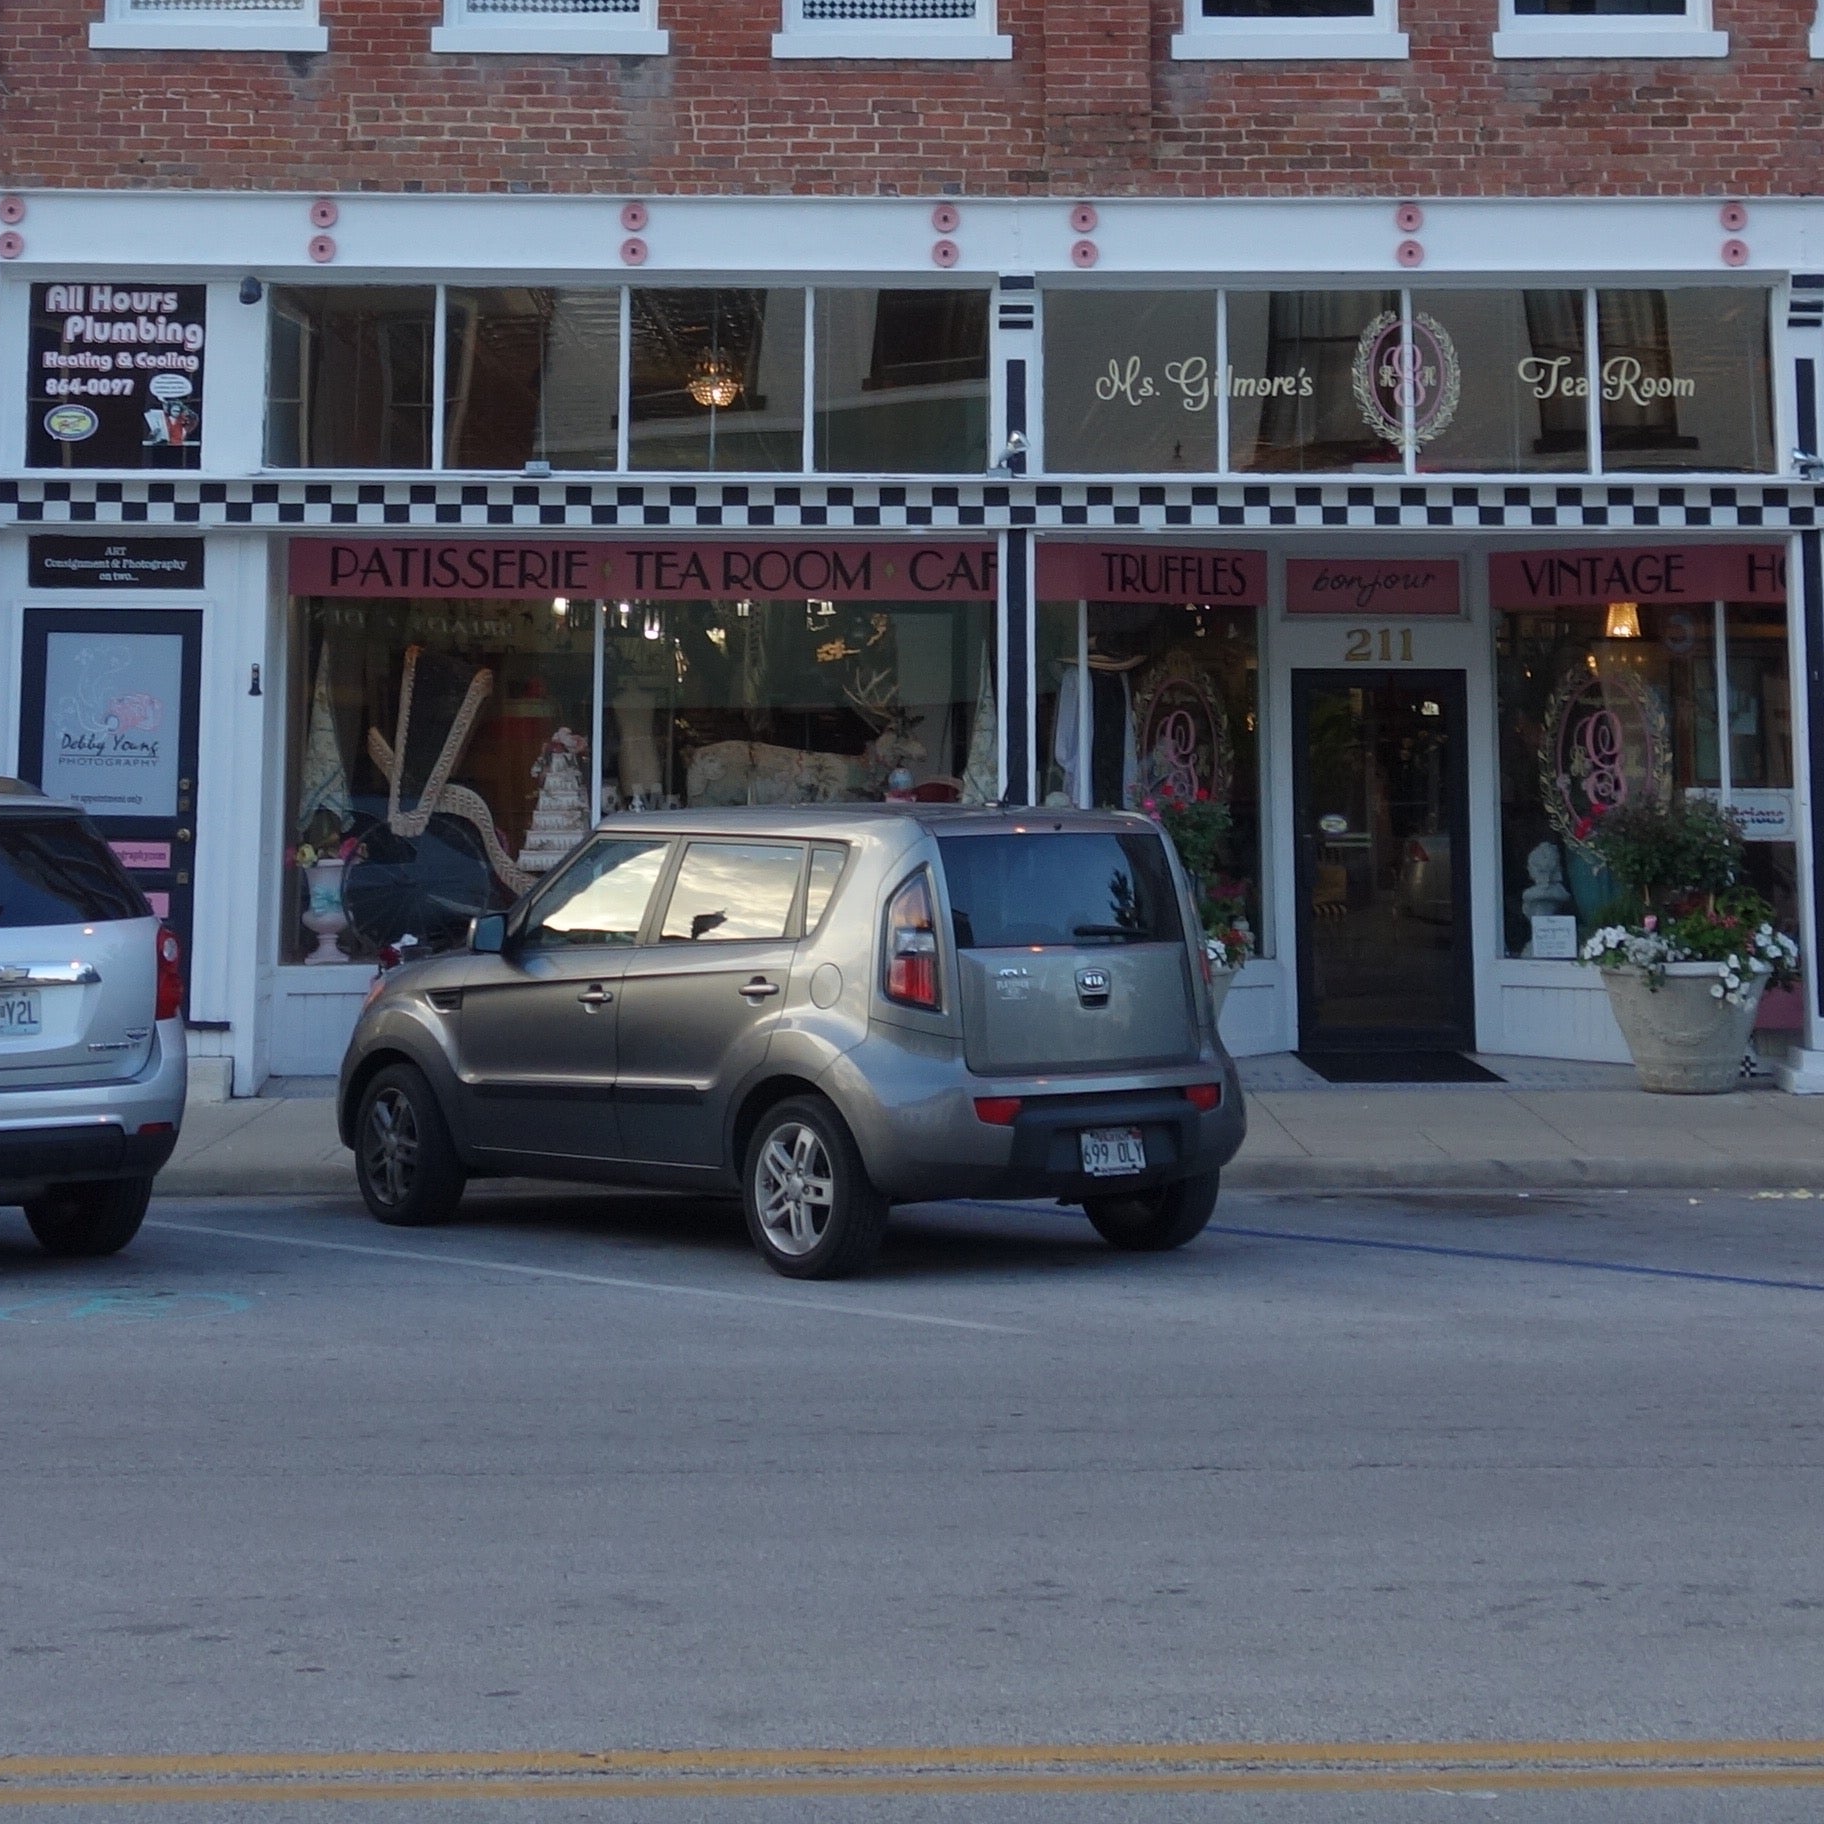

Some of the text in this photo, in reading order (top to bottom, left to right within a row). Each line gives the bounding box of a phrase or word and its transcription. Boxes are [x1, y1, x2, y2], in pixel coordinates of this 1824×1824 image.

[45, 285, 178, 313] All Hours
[64, 315, 204, 351] Plumbing
[43, 351, 199, 372] Heating & Cooling
[45, 378, 134, 396] 864-0097
[1096, 356, 1160, 406] Ms.
[1165, 357, 1313, 411] Gilmore's
[1518, 356, 1695, 406] Tea Room
[331, 547, 997, 591] PATISSERIE TEA ROOM CAF
[1101, 553, 1246, 596] TRUFFLES
[1521, 554, 1684, 597] VINTAGE
[1312, 569, 1433, 607] bonjour
[1345, 630, 1412, 661] 211
[58, 758, 158, 767] PHOTOGRAPHY
[6, 1000, 38, 1026] Y2L
